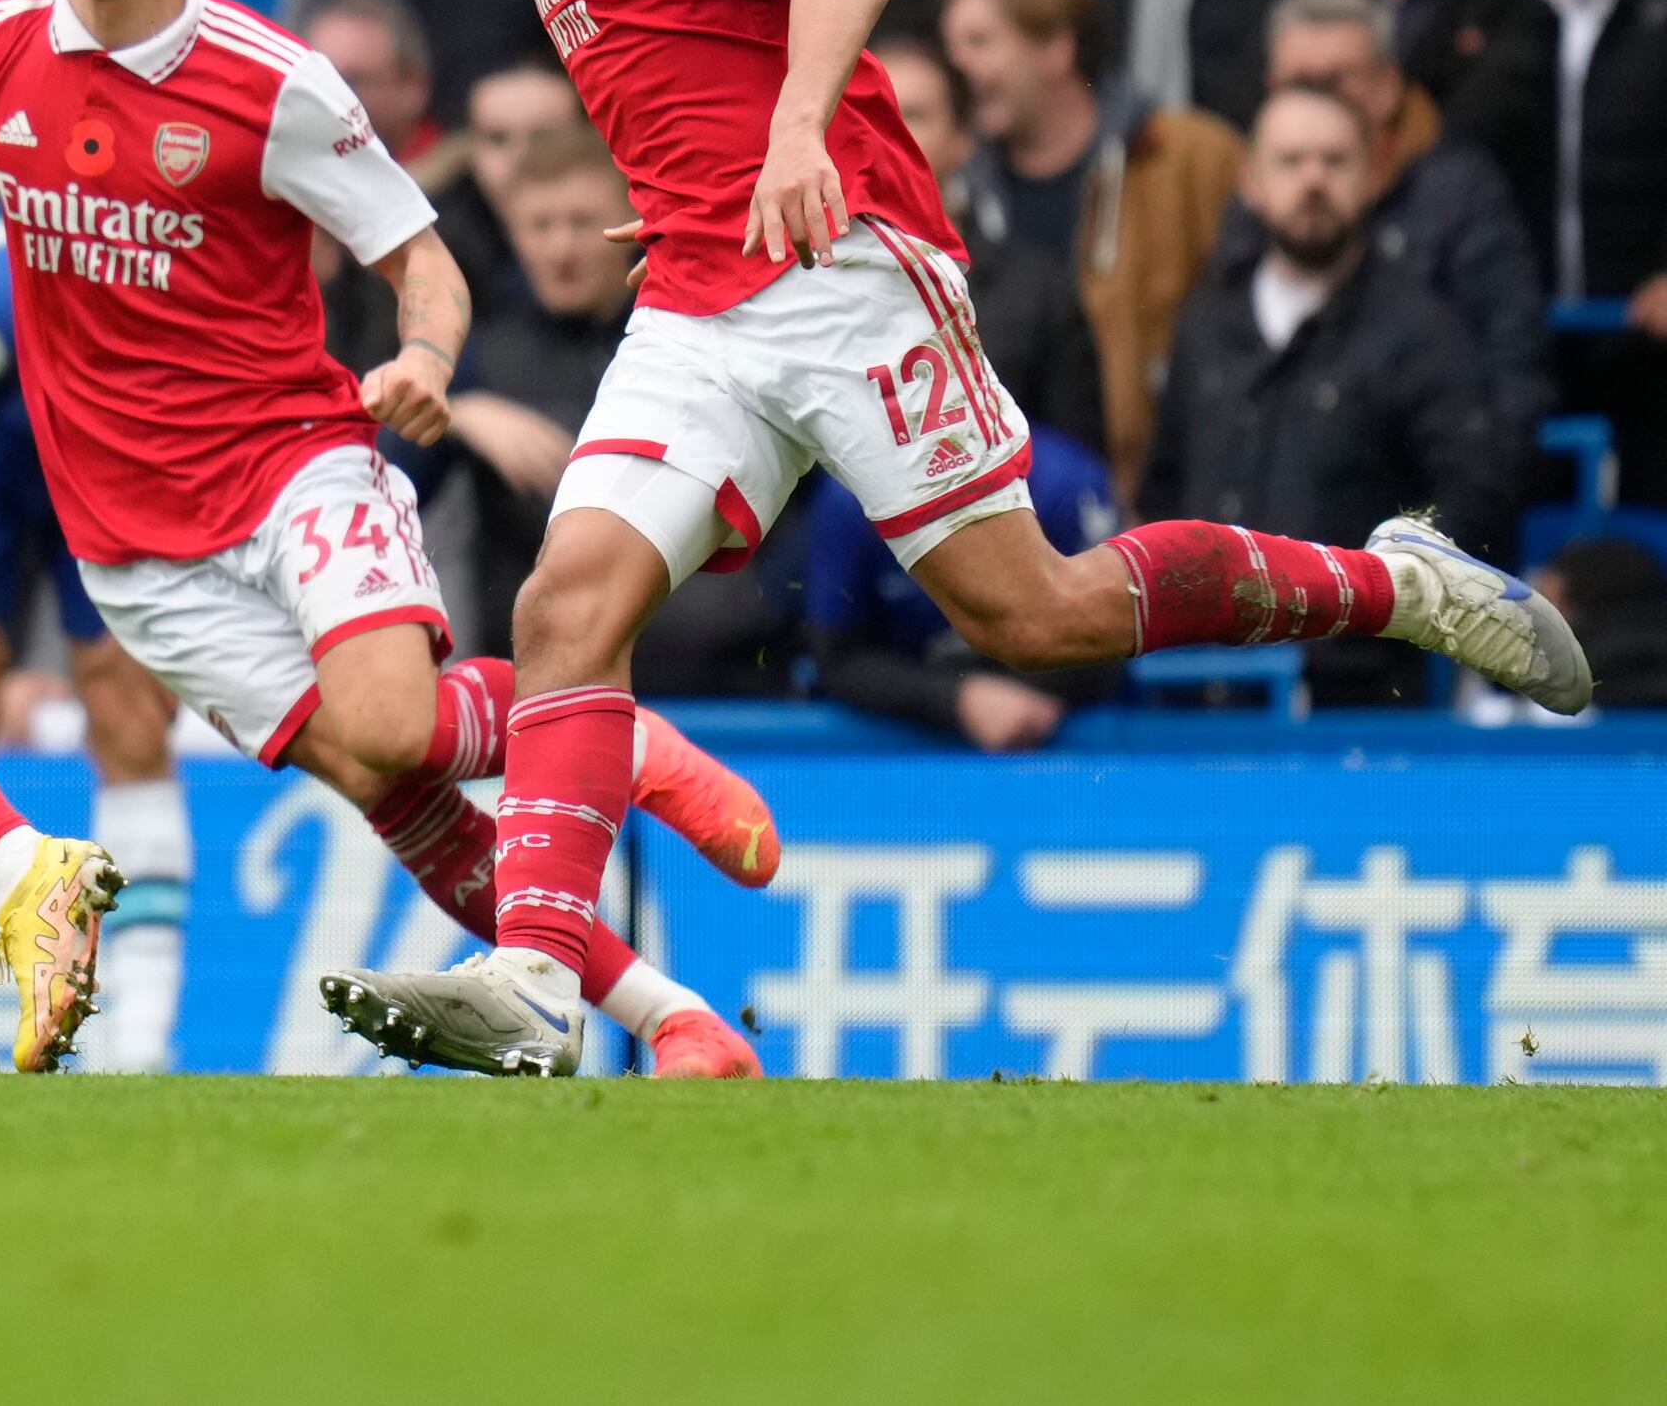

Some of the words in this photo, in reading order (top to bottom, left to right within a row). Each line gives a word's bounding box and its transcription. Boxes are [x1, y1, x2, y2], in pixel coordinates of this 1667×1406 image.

[23, 231, 63, 274] FLY
[70, 240, 171, 292] BETTER
[866, 344, 968, 447] 12
[925, 451, 974, 478] adidas
[289, 502, 390, 586] 34
